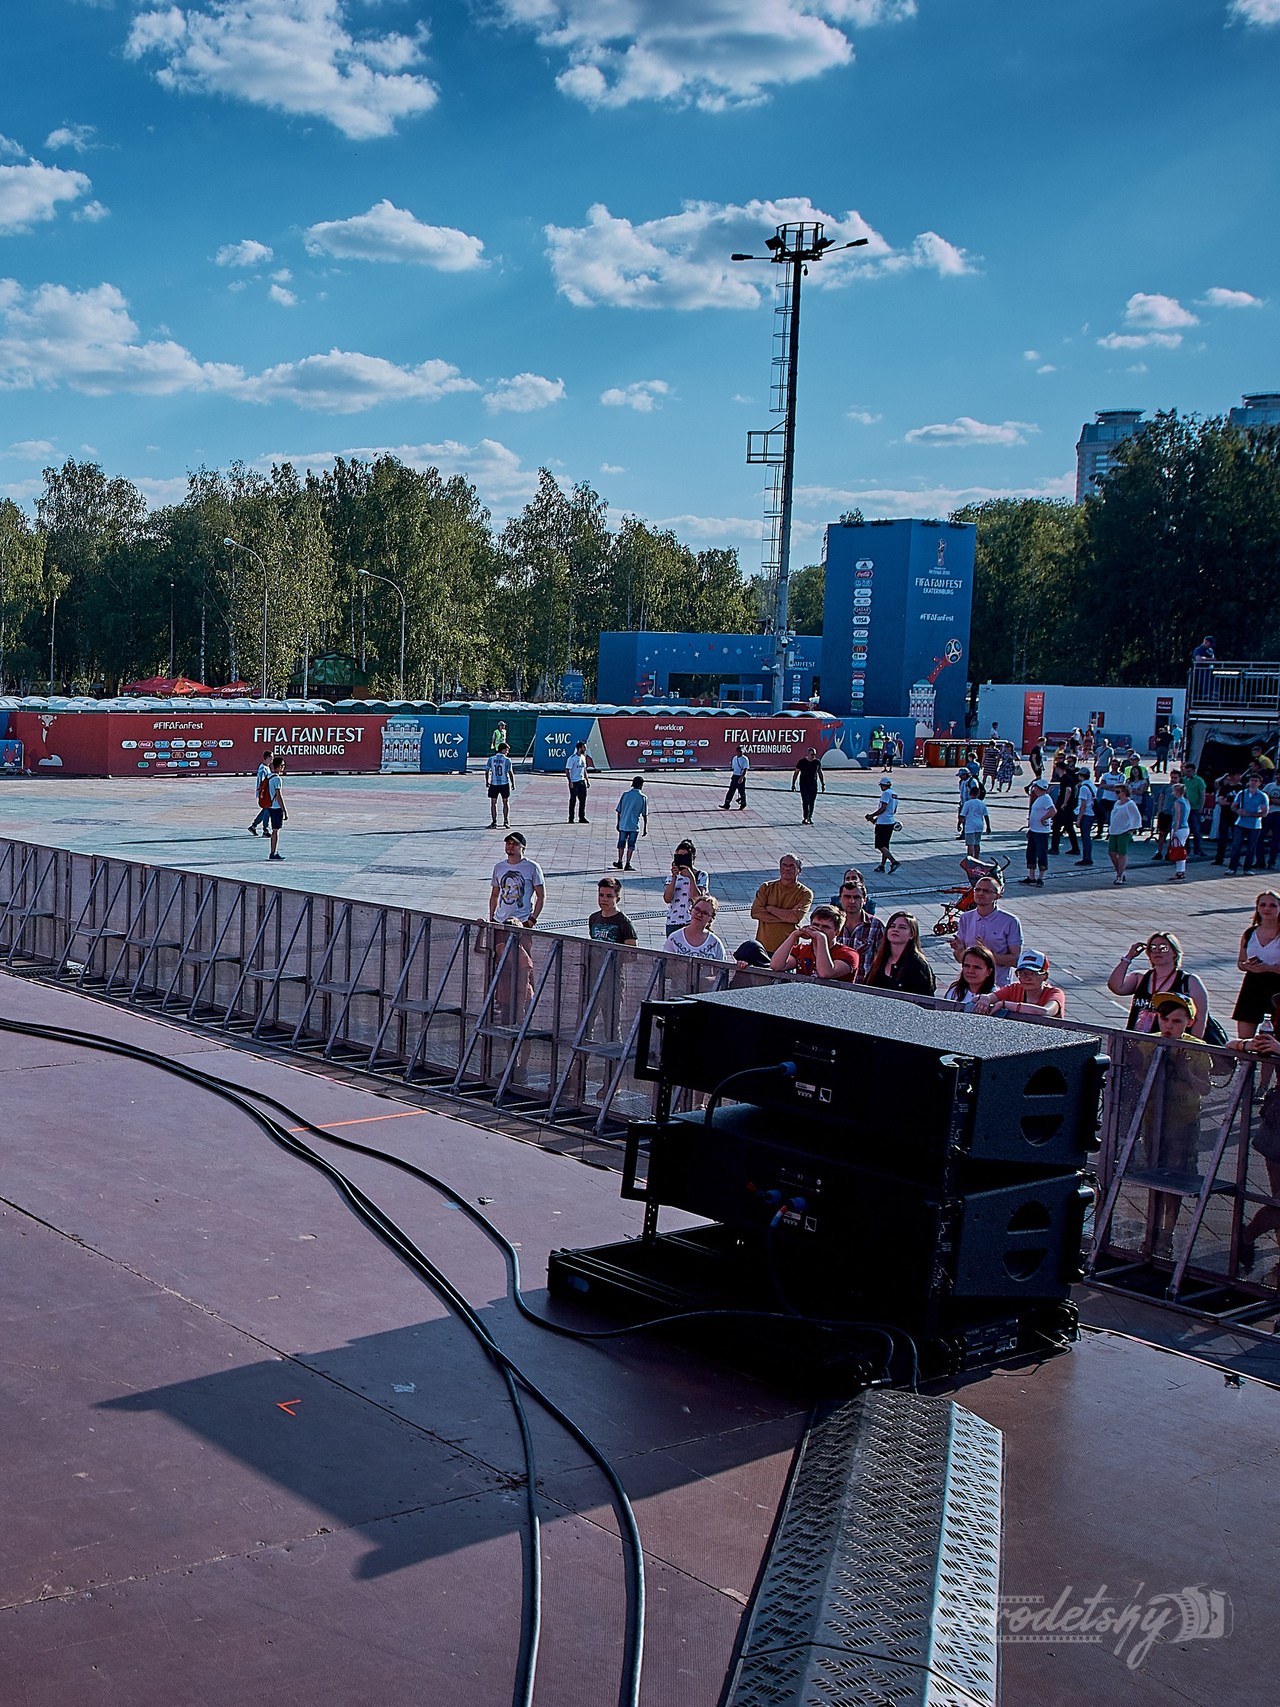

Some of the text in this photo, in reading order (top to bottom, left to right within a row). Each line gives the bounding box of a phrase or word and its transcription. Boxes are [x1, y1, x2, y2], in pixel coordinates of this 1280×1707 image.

[915, 578, 963, 588] FIFA FAN FEST
[153, 722, 204, 730] #FIFAFanFest
[654, 724, 684, 732] #worldcup
[254, 727, 365, 742] FIFA FAN FEST
[434, 733, 452, 744] WC
[555, 733, 572, 744] WC
[724, 729, 806, 742] FIFA FAN FEST
[274, 745, 345, 755] EKATERINBURG
[438, 749, 452, 758] WC
[548, 748, 562, 757] WC
[494, 765, 503, 776] 10
